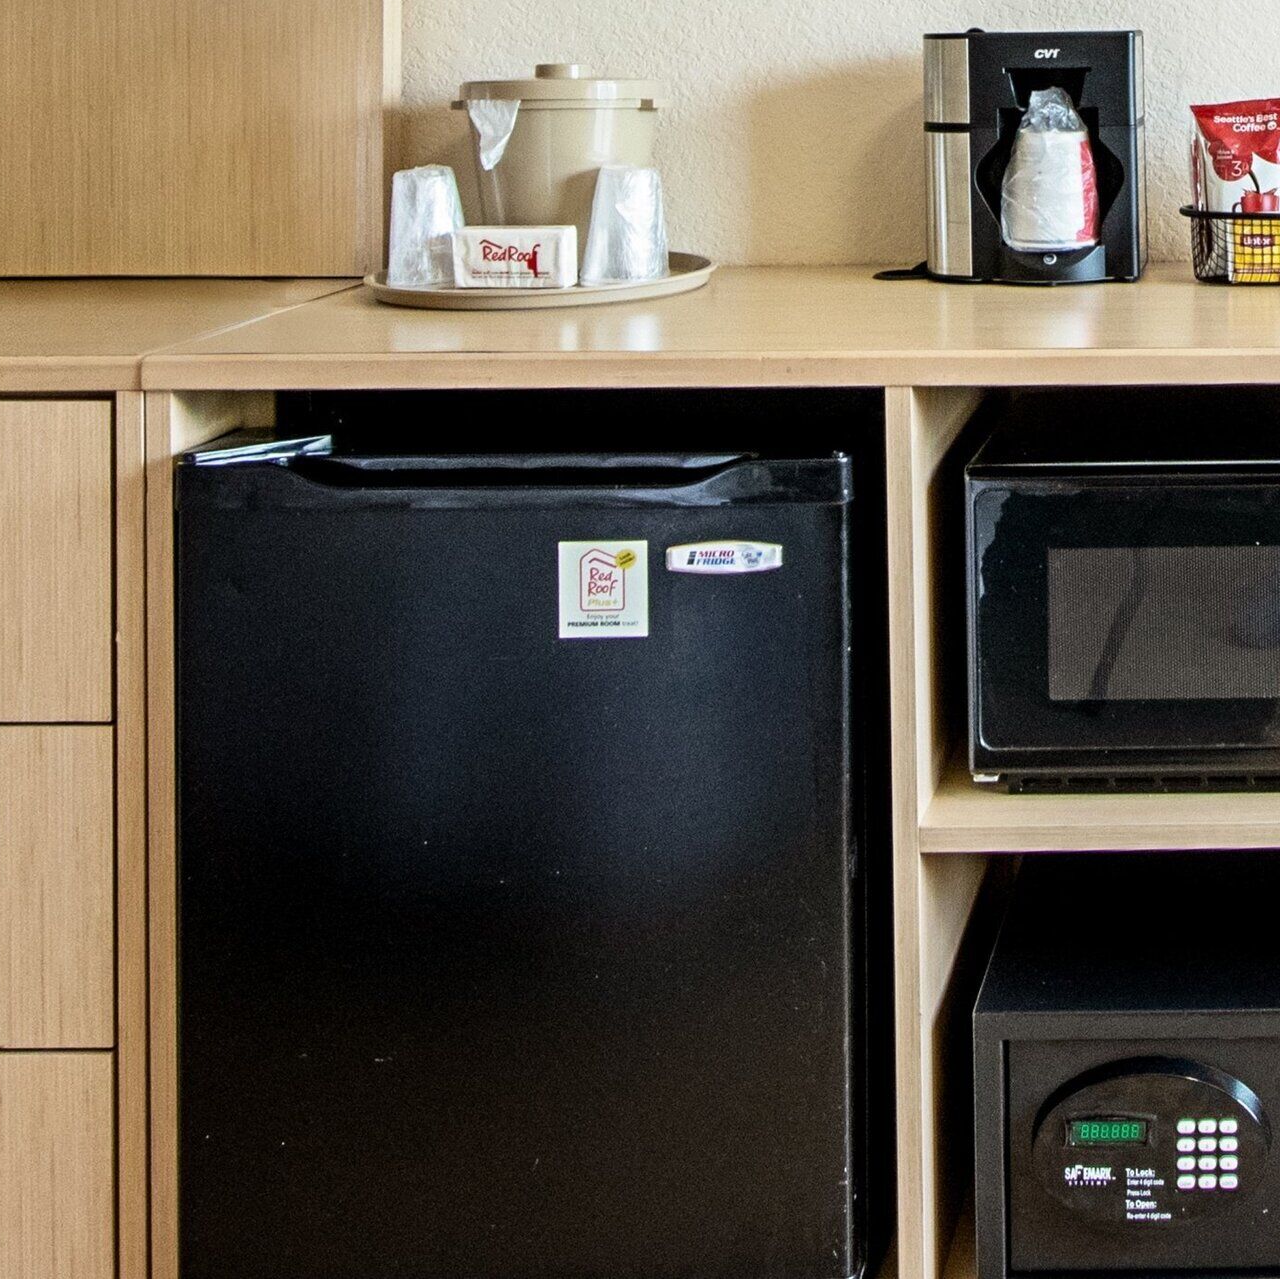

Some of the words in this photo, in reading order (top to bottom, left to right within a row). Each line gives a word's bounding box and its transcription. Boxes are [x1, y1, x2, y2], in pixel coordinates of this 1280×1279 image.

[1256, 113, 1278, 123] Best
[1233, 123, 1266, 132] Coffee
[1231, 160, 1241, 176] 3
[699, 550, 735, 558] MICRO
[589, 567, 613, 581] Red
[588, 580, 618, 597] Roof
[1064, 1165, 1112, 1180] SAFEMARK
[1125, 1168, 1135, 1177] To
[1135, 1168, 1156, 1177] Lock:
[1125, 1200, 1135, 1209] To
[1135, 1199, 1157, 1209] Open:
